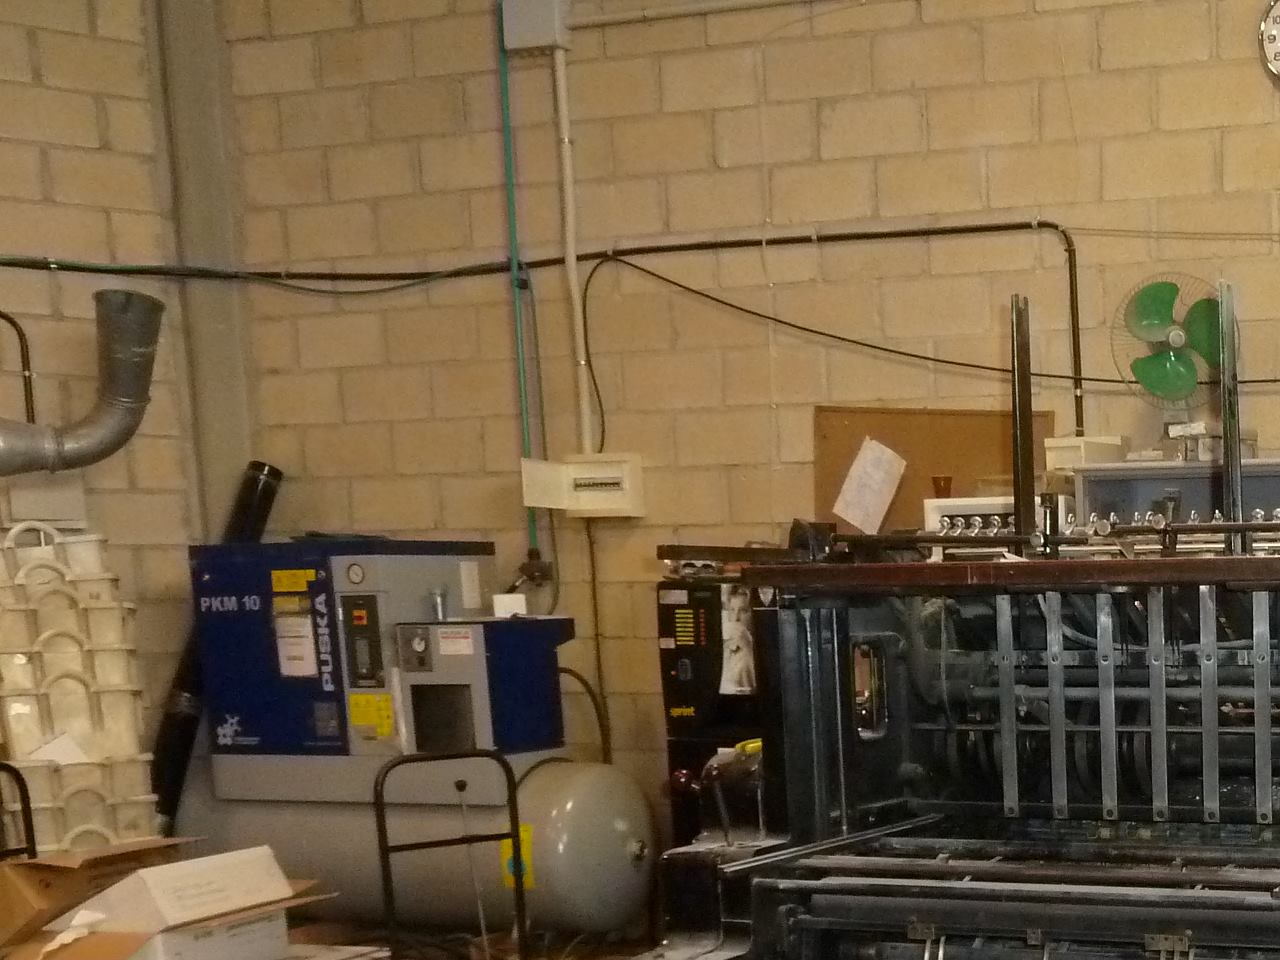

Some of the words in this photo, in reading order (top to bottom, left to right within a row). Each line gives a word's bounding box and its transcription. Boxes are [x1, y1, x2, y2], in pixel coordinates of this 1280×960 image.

[1267, 34, 1277, 44] 9
[200, 595, 238, 612] PKM
[241, 594, 260, 611] 10
[314, 593, 335, 692] PUSKA
